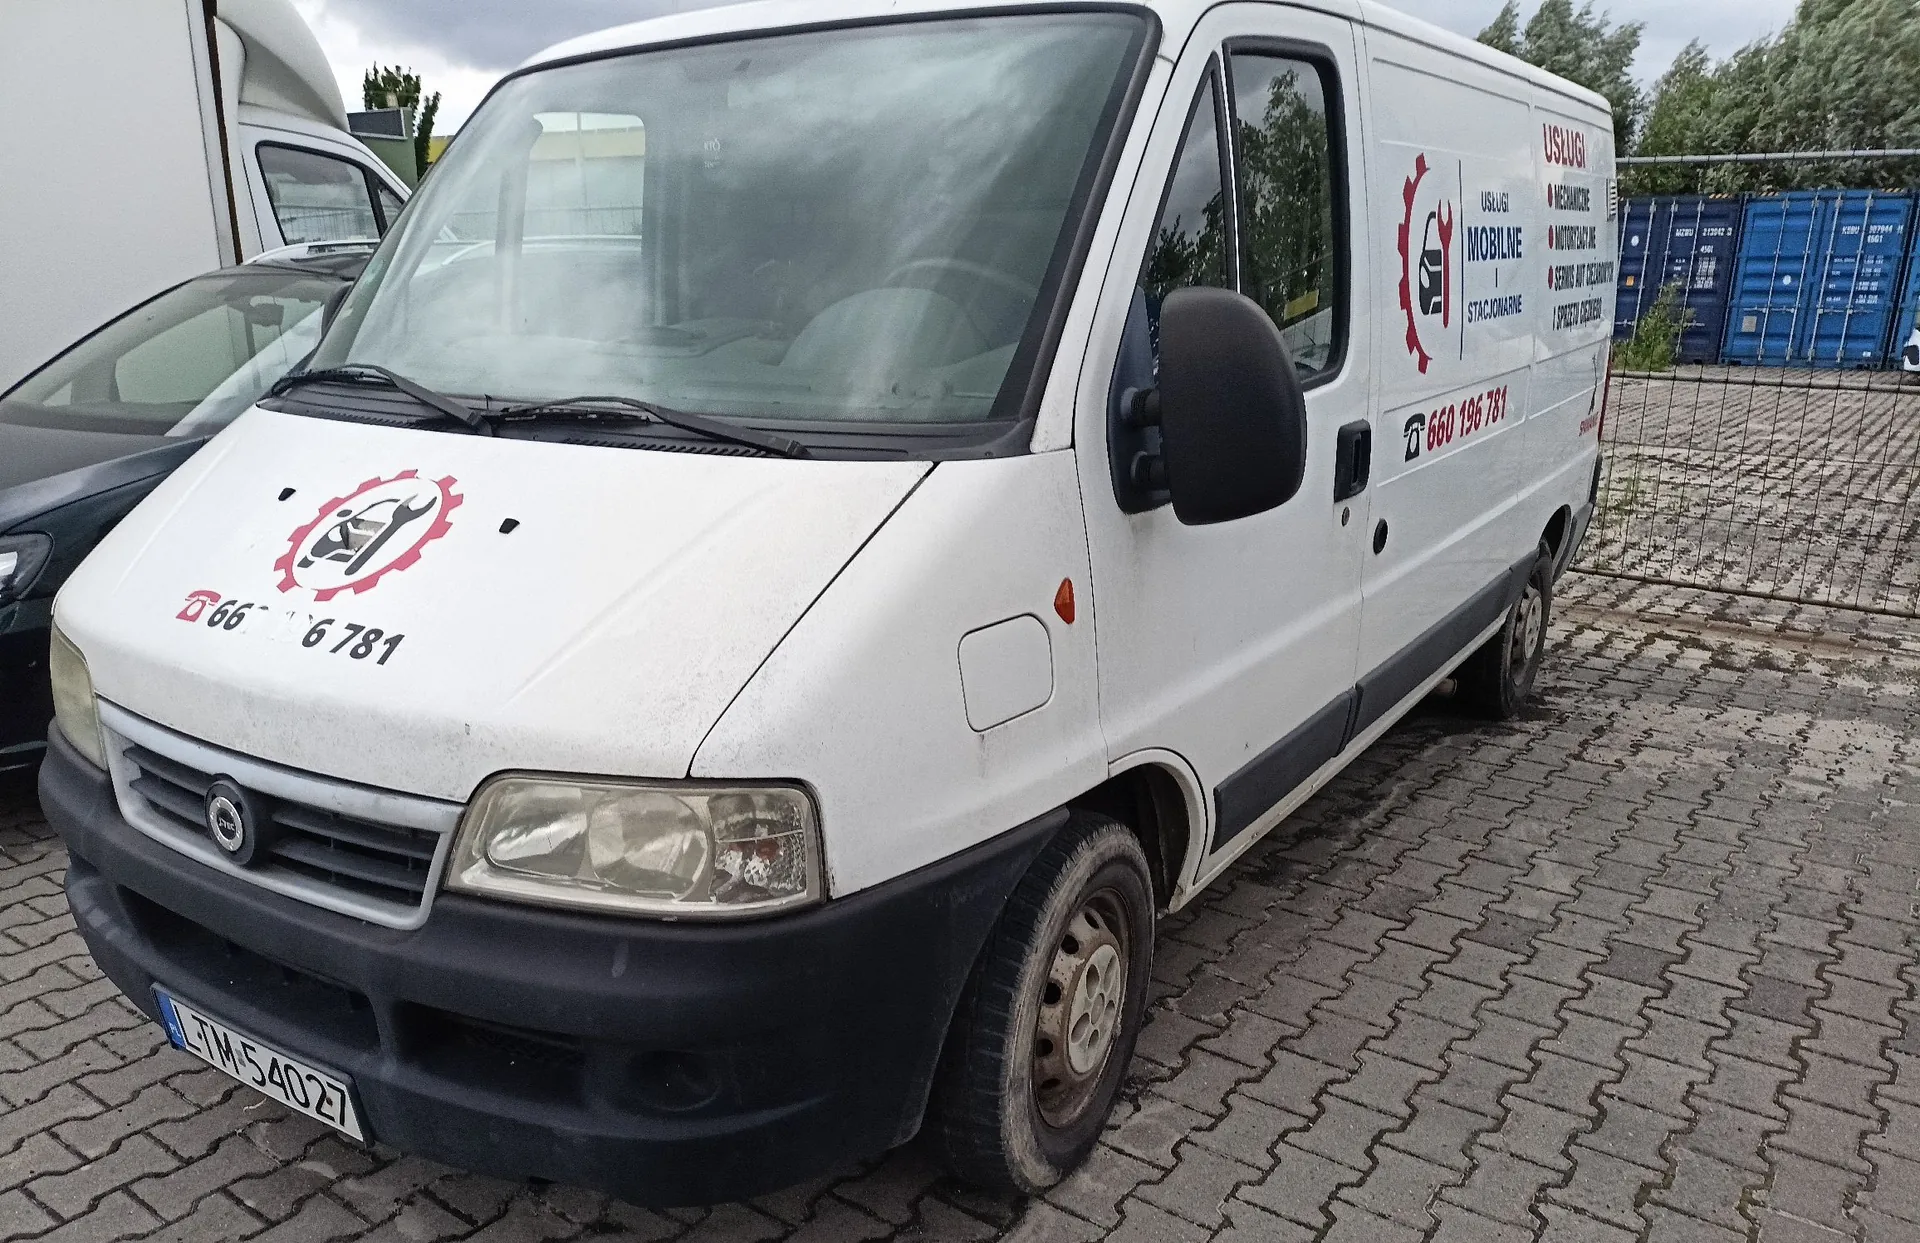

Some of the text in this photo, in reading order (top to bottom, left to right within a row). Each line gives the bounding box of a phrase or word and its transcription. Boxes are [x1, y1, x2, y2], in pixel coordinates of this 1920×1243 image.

[1543, 123, 1586, 168] USŁUGI
[1481, 190, 1509, 213] USŁUGI
[1467, 226, 1522, 262] MOBILNE
[1467, 294, 1522, 324] STACJONARNE
[1427, 384, 1508, 451] 660 196 781
[329, 623, 406, 667] 781
[169, 1021, 183, 1039] PL
[174, 1004, 346, 1127] LTM 54027
